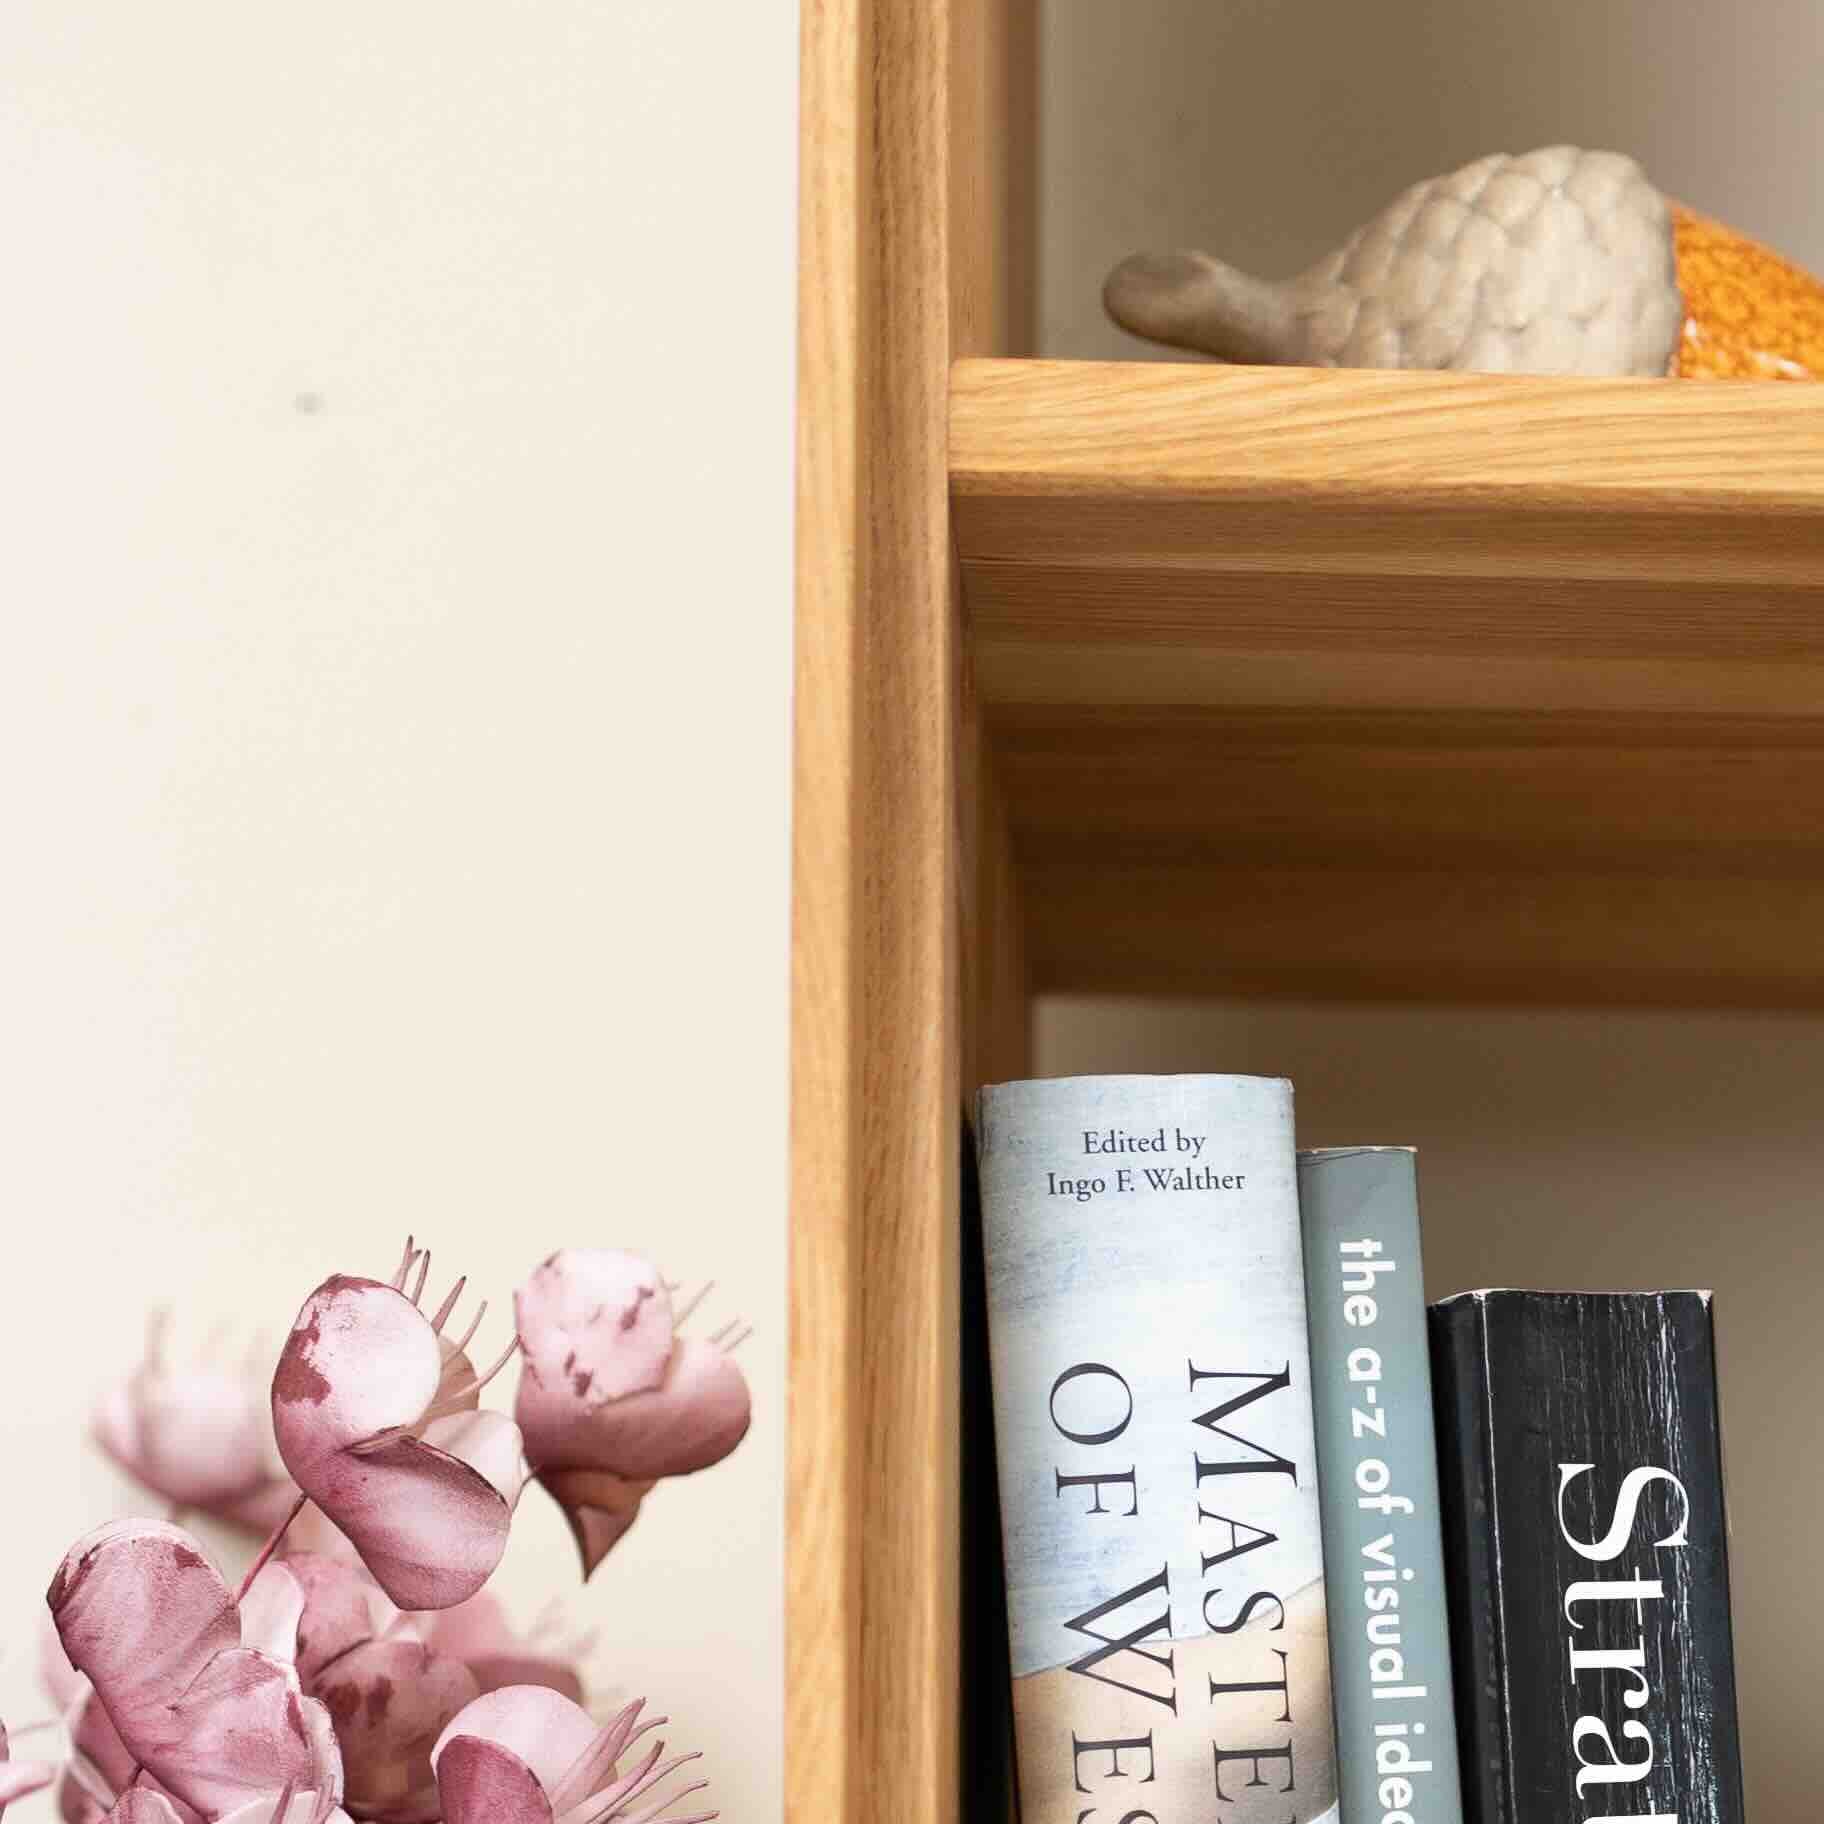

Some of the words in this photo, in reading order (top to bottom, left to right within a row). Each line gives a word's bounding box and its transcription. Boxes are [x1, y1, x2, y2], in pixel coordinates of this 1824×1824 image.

[1046, 1172, 1106, 1202] Ingo
[1116, 1169, 1135, 1192] F.
[1143, 1166, 1246, 1191] Walther
[1082, 1128, 1168, 1154] Edited
[1176, 1128, 1206, 1158] by
[1339, 1238, 1396, 1327] the
[1347, 1347, 1385, 1438] a-z
[1049, 1362, 1138, 1516] OF
[1355, 1458, 1414, 1515] of
[1361, 1533, 1427, 1700] visual
